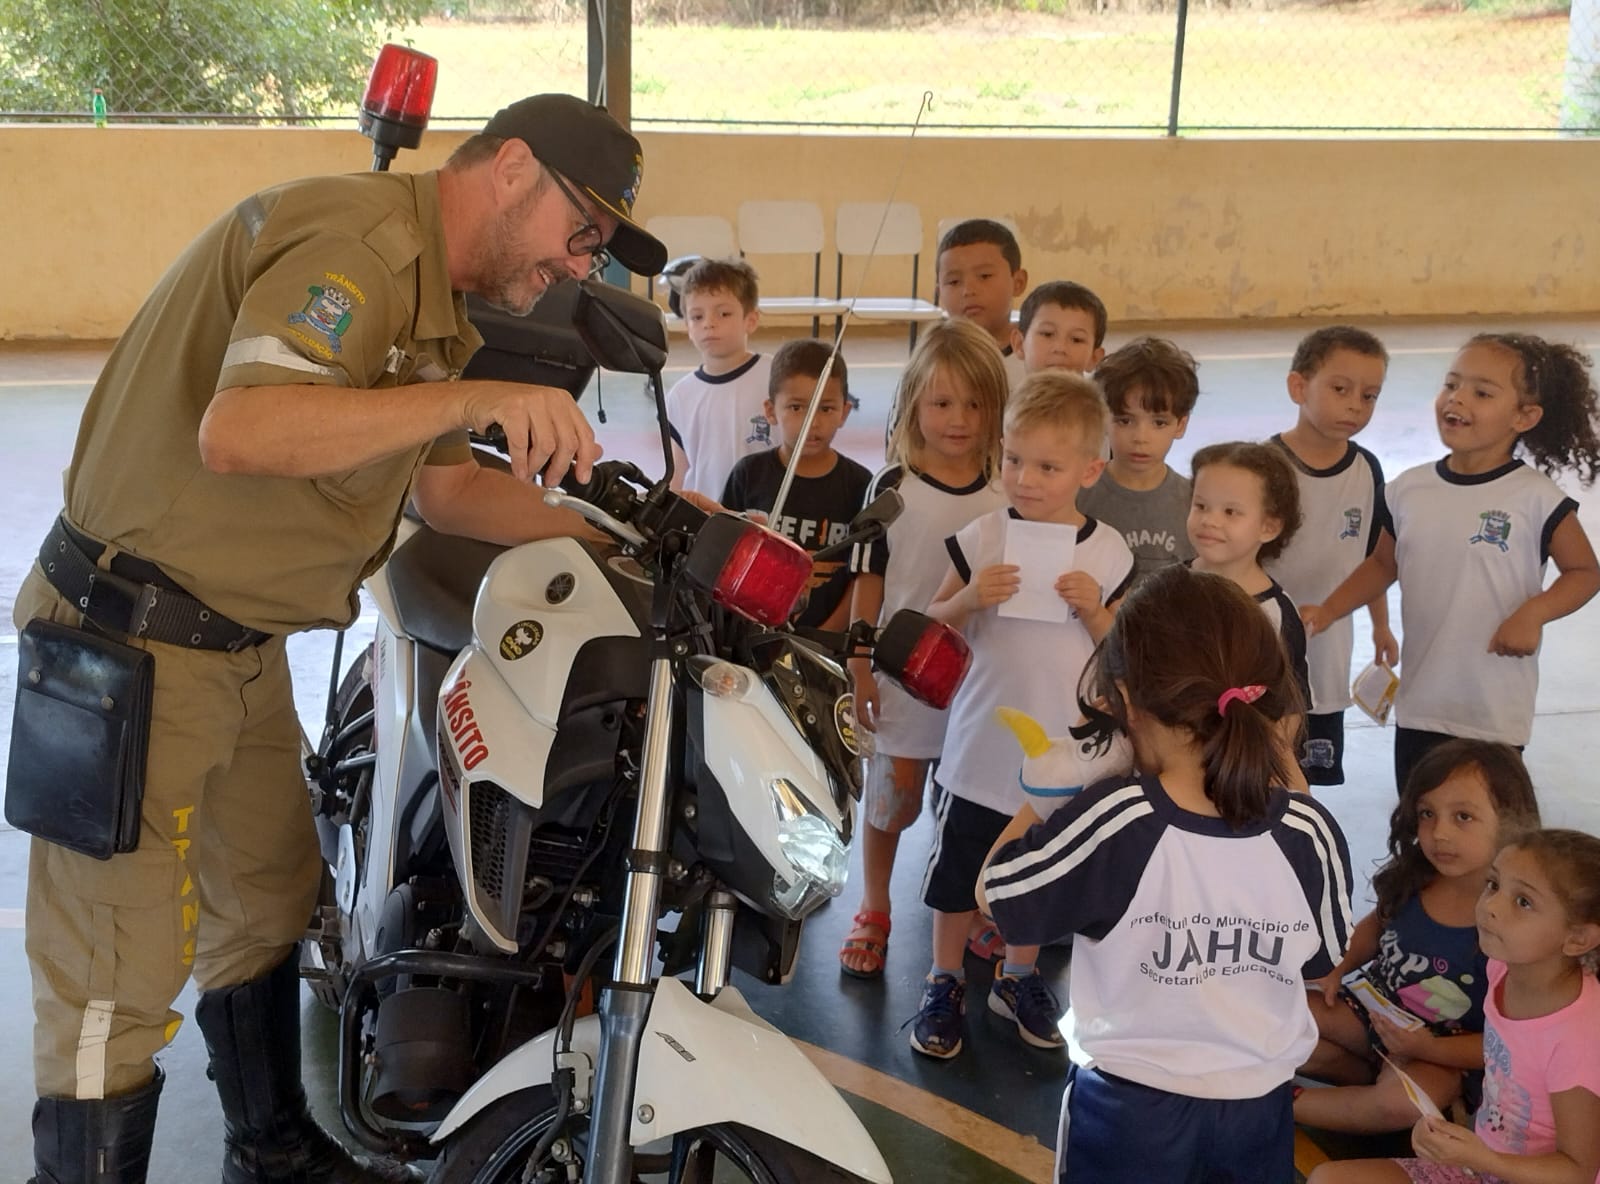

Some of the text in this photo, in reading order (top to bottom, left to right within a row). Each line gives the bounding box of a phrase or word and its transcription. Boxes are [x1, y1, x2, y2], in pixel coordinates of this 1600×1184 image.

[1126, 529, 1176, 552] HANG
[444, 667, 489, 771] ÂNSITO
[1191, 913, 1211, 925] do
[1216, 915, 1289, 934] Município
[1293, 919, 1310, 932] de
[1151, 928, 1284, 971] JAHU
[1202, 966, 1217, 980] de
[1221, 963, 1294, 986] Educação
